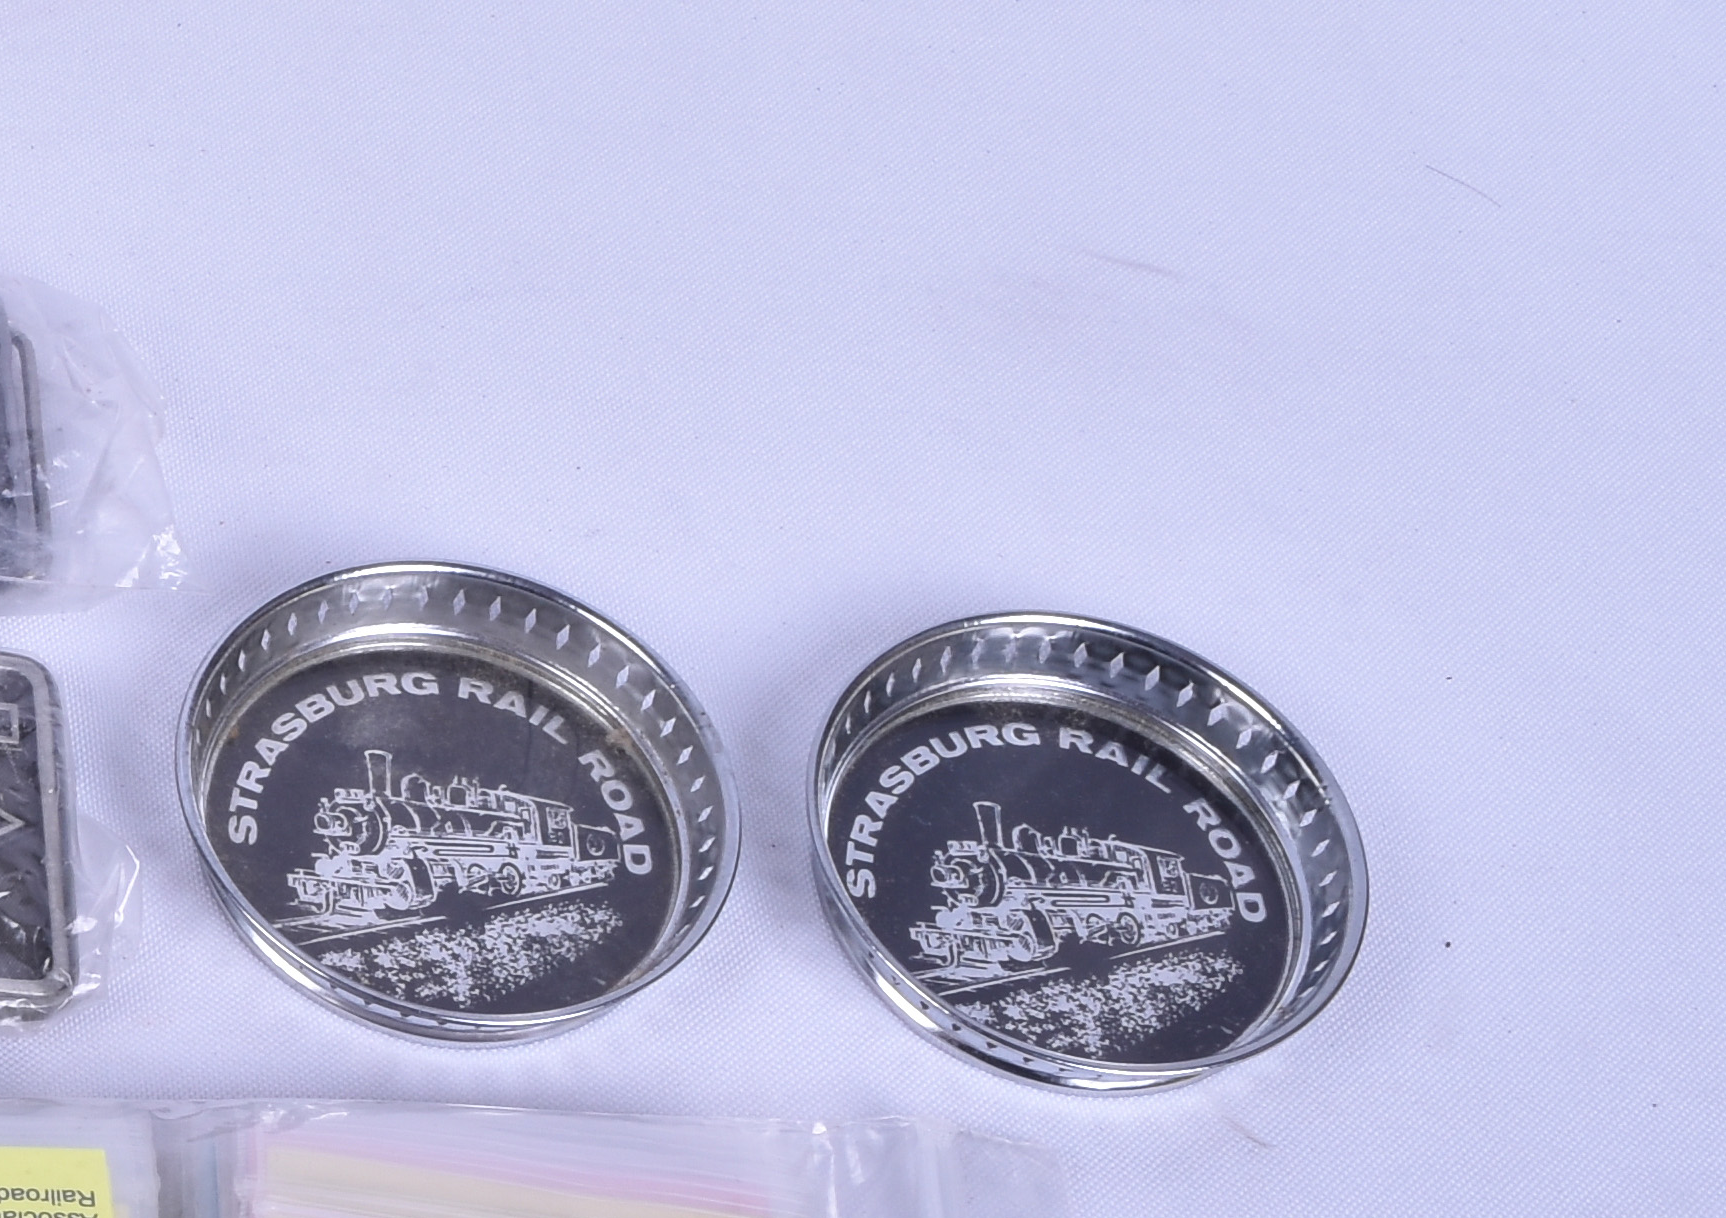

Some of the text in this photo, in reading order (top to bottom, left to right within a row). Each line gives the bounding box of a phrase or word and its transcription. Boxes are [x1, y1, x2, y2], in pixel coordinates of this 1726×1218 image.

[229, 670, 654, 877] STRASBURG RAIL ROAD
[845, 721, 1268, 924] STRASBURG RAIL ROAD
